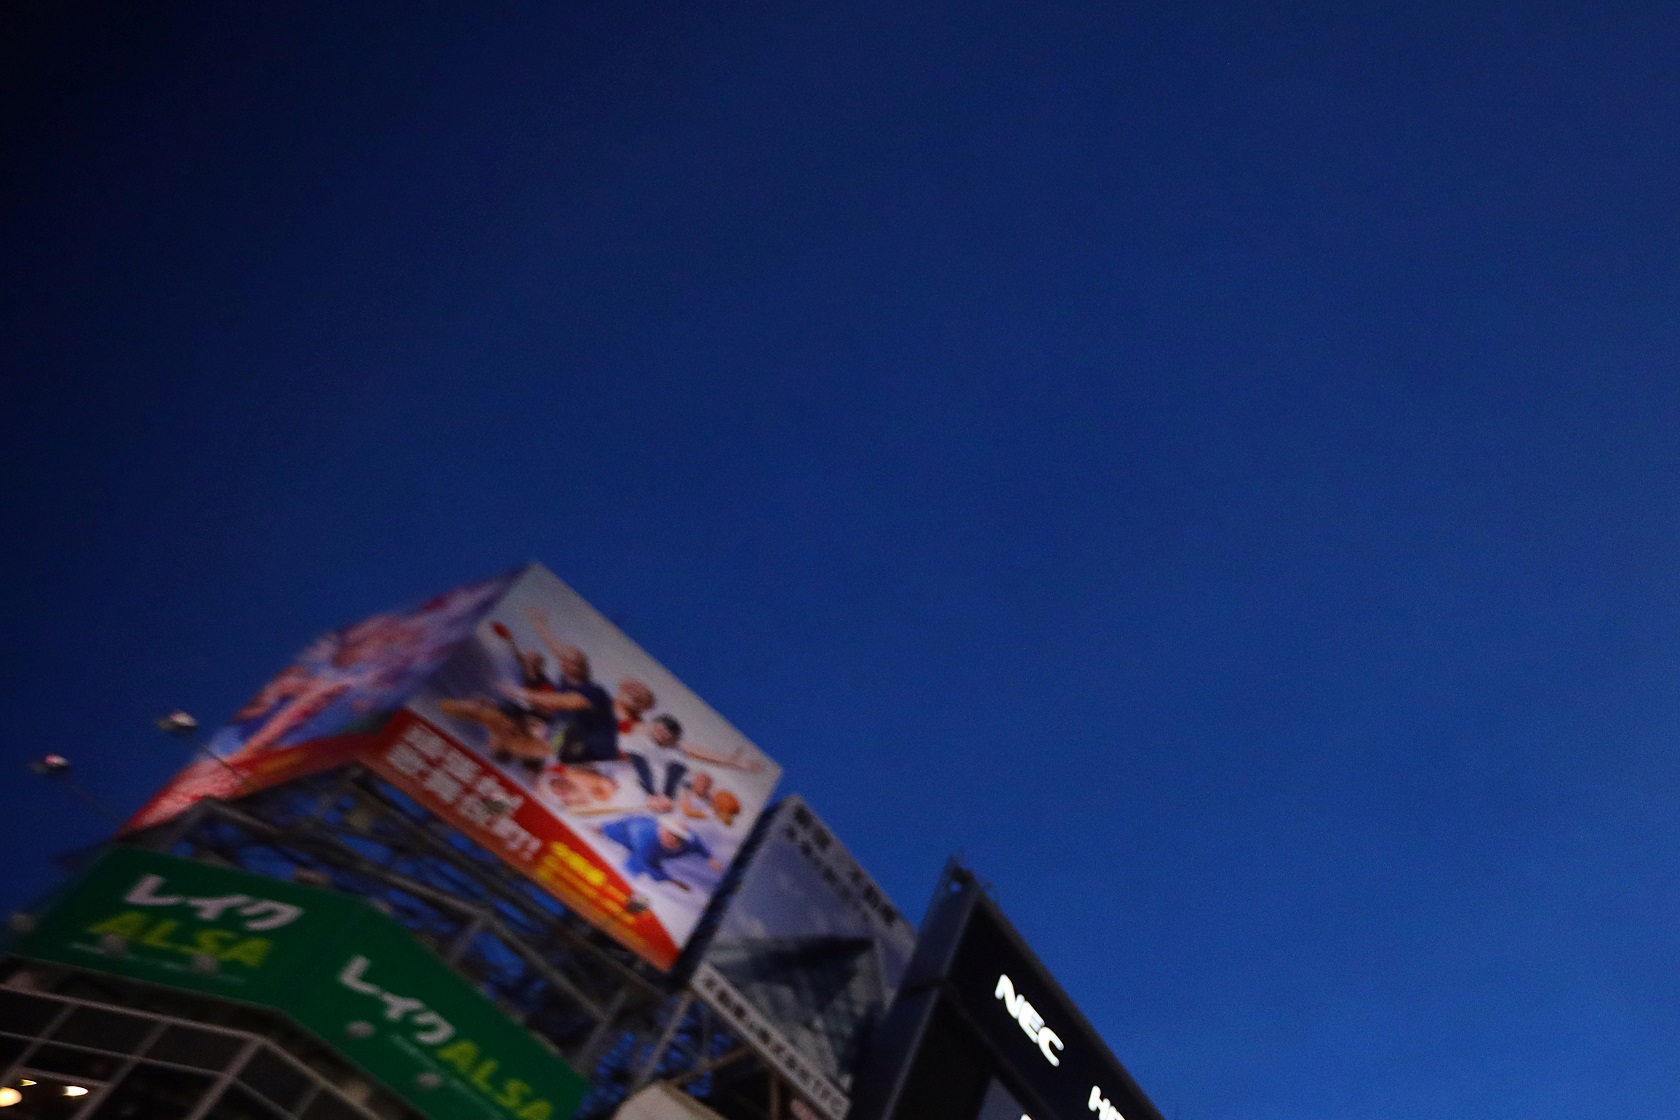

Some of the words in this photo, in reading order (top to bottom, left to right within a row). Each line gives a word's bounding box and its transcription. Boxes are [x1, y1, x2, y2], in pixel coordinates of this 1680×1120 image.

[124, 874, 303, 931] レイク
[88, 912, 273, 968] ALSA
[339, 955, 456, 1045] レイク
[994, 973, 1065, 1067] NEC
